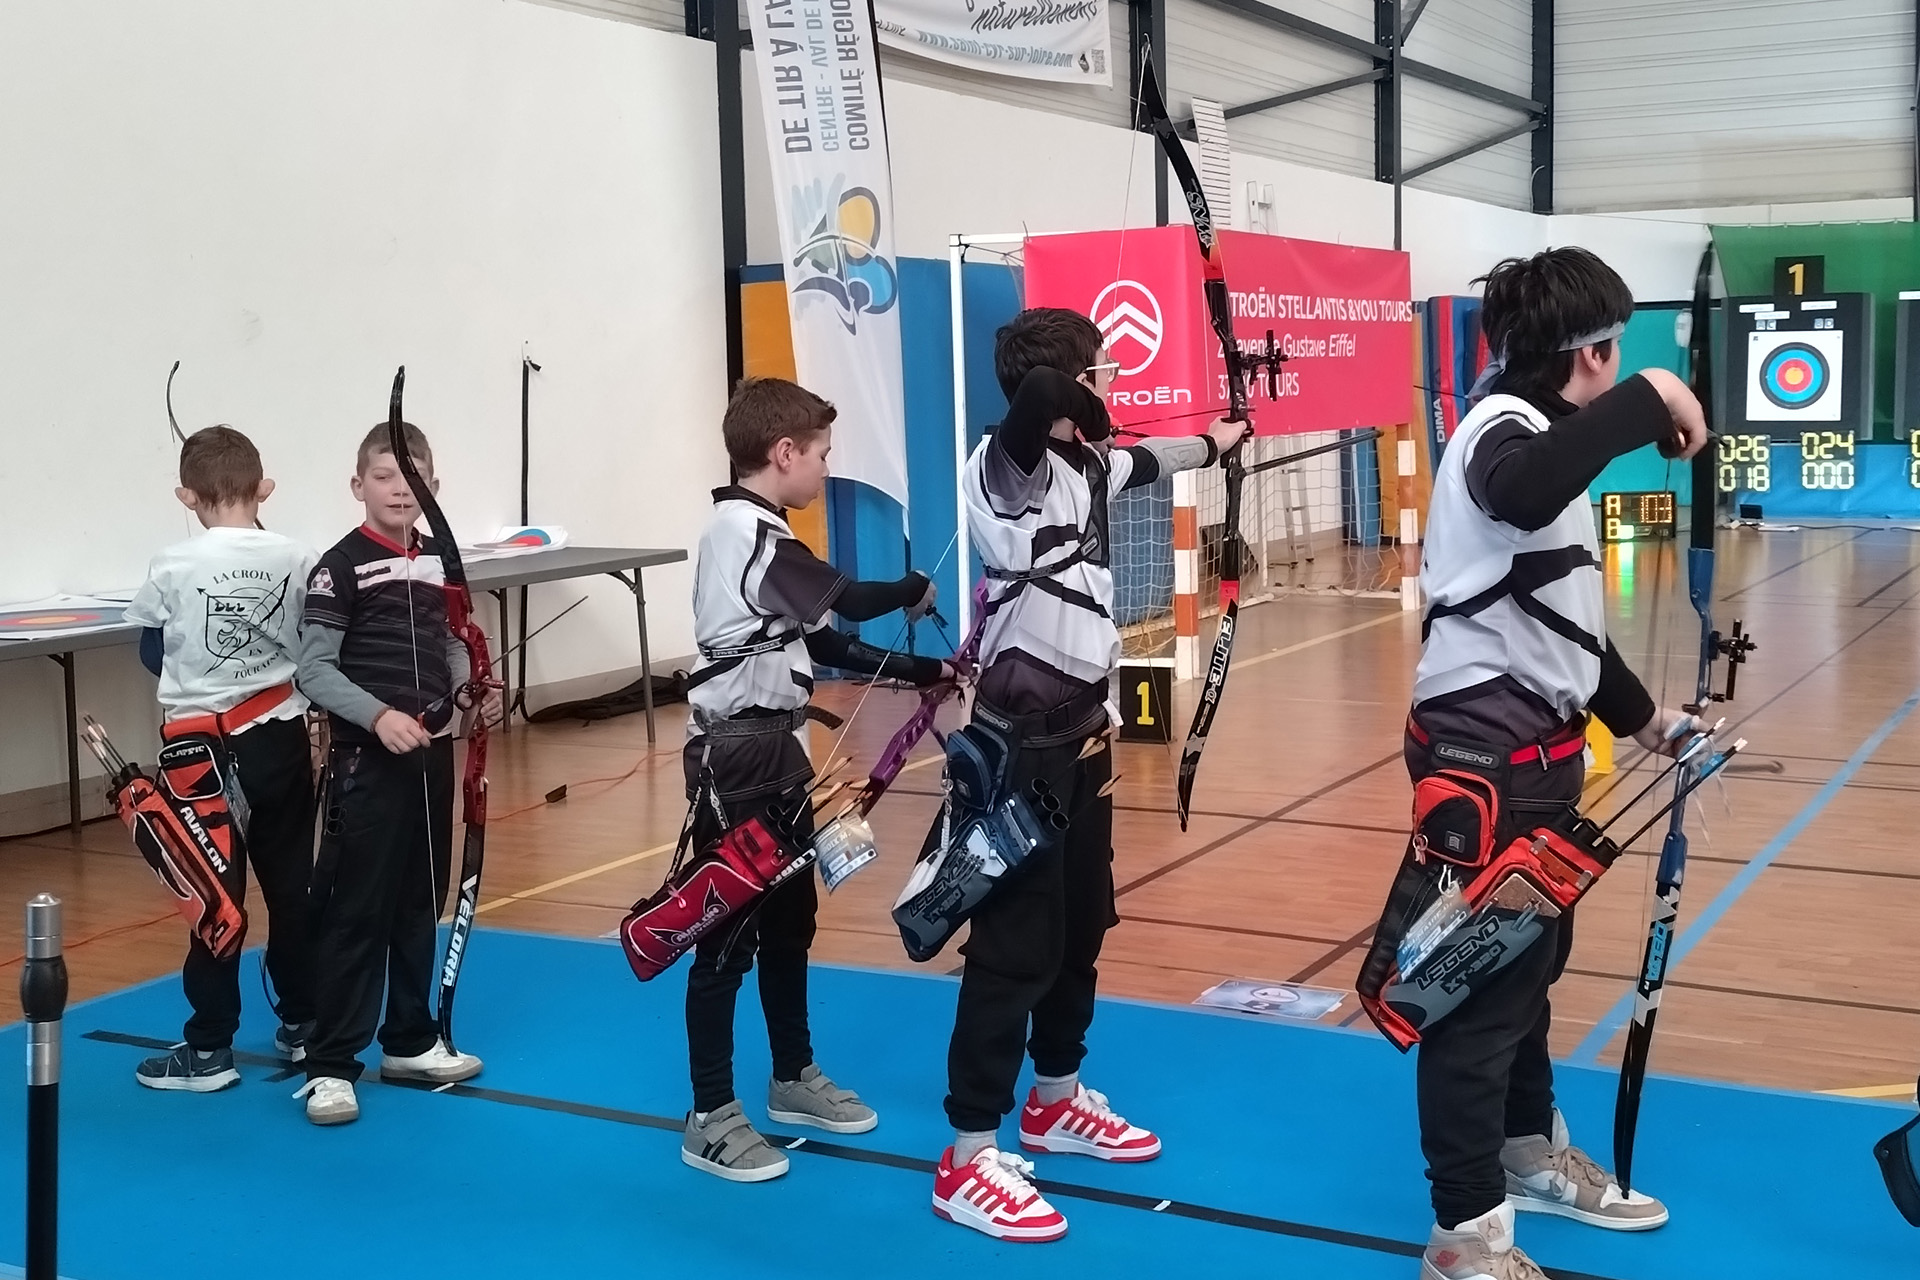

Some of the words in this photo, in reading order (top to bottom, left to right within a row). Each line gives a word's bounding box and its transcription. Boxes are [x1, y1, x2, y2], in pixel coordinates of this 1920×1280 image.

[917, 29, 1075, 68] www.saint-cyr-sur-loire.com
[1788, 263, 1804, 295] 1
[1228, 287, 1276, 318] TROËN
[1278, 294, 1347, 321] STELLANTIS
[1348, 298, 1378, 322] &YOU
[1379, 300, 1413, 322] TOURS
[1236, 339, 1280, 357] avene
[1283, 333, 1326, 358] Gustave
[1329, 334, 1356, 357] Eiffel
[1107, 386, 1192, 407] ROËN
[1218, 373, 1255, 400] 370
[1433, 398, 1446, 443] DIMA
[1719, 435, 1769, 462] 026
[1802, 431, 1854, 459] 024
[1719, 464, 1770, 492] 018
[1802, 462, 1854, 490] 000
[1606, 495, 1620, 515] A
[213, 572, 229, 584] LA
[232, 569, 273, 582] CROIX
[248, 648, 262, 656] EN
[1137, 681, 1154, 725] 1
[1440, 747, 1493, 765] LEGEND
[180, 806, 227, 873] AVALON
[443, 874, 478, 987] VELORA
[1415, 915, 1501, 991] LEGEND
[1444, 944, 1502, 992] XT-320
